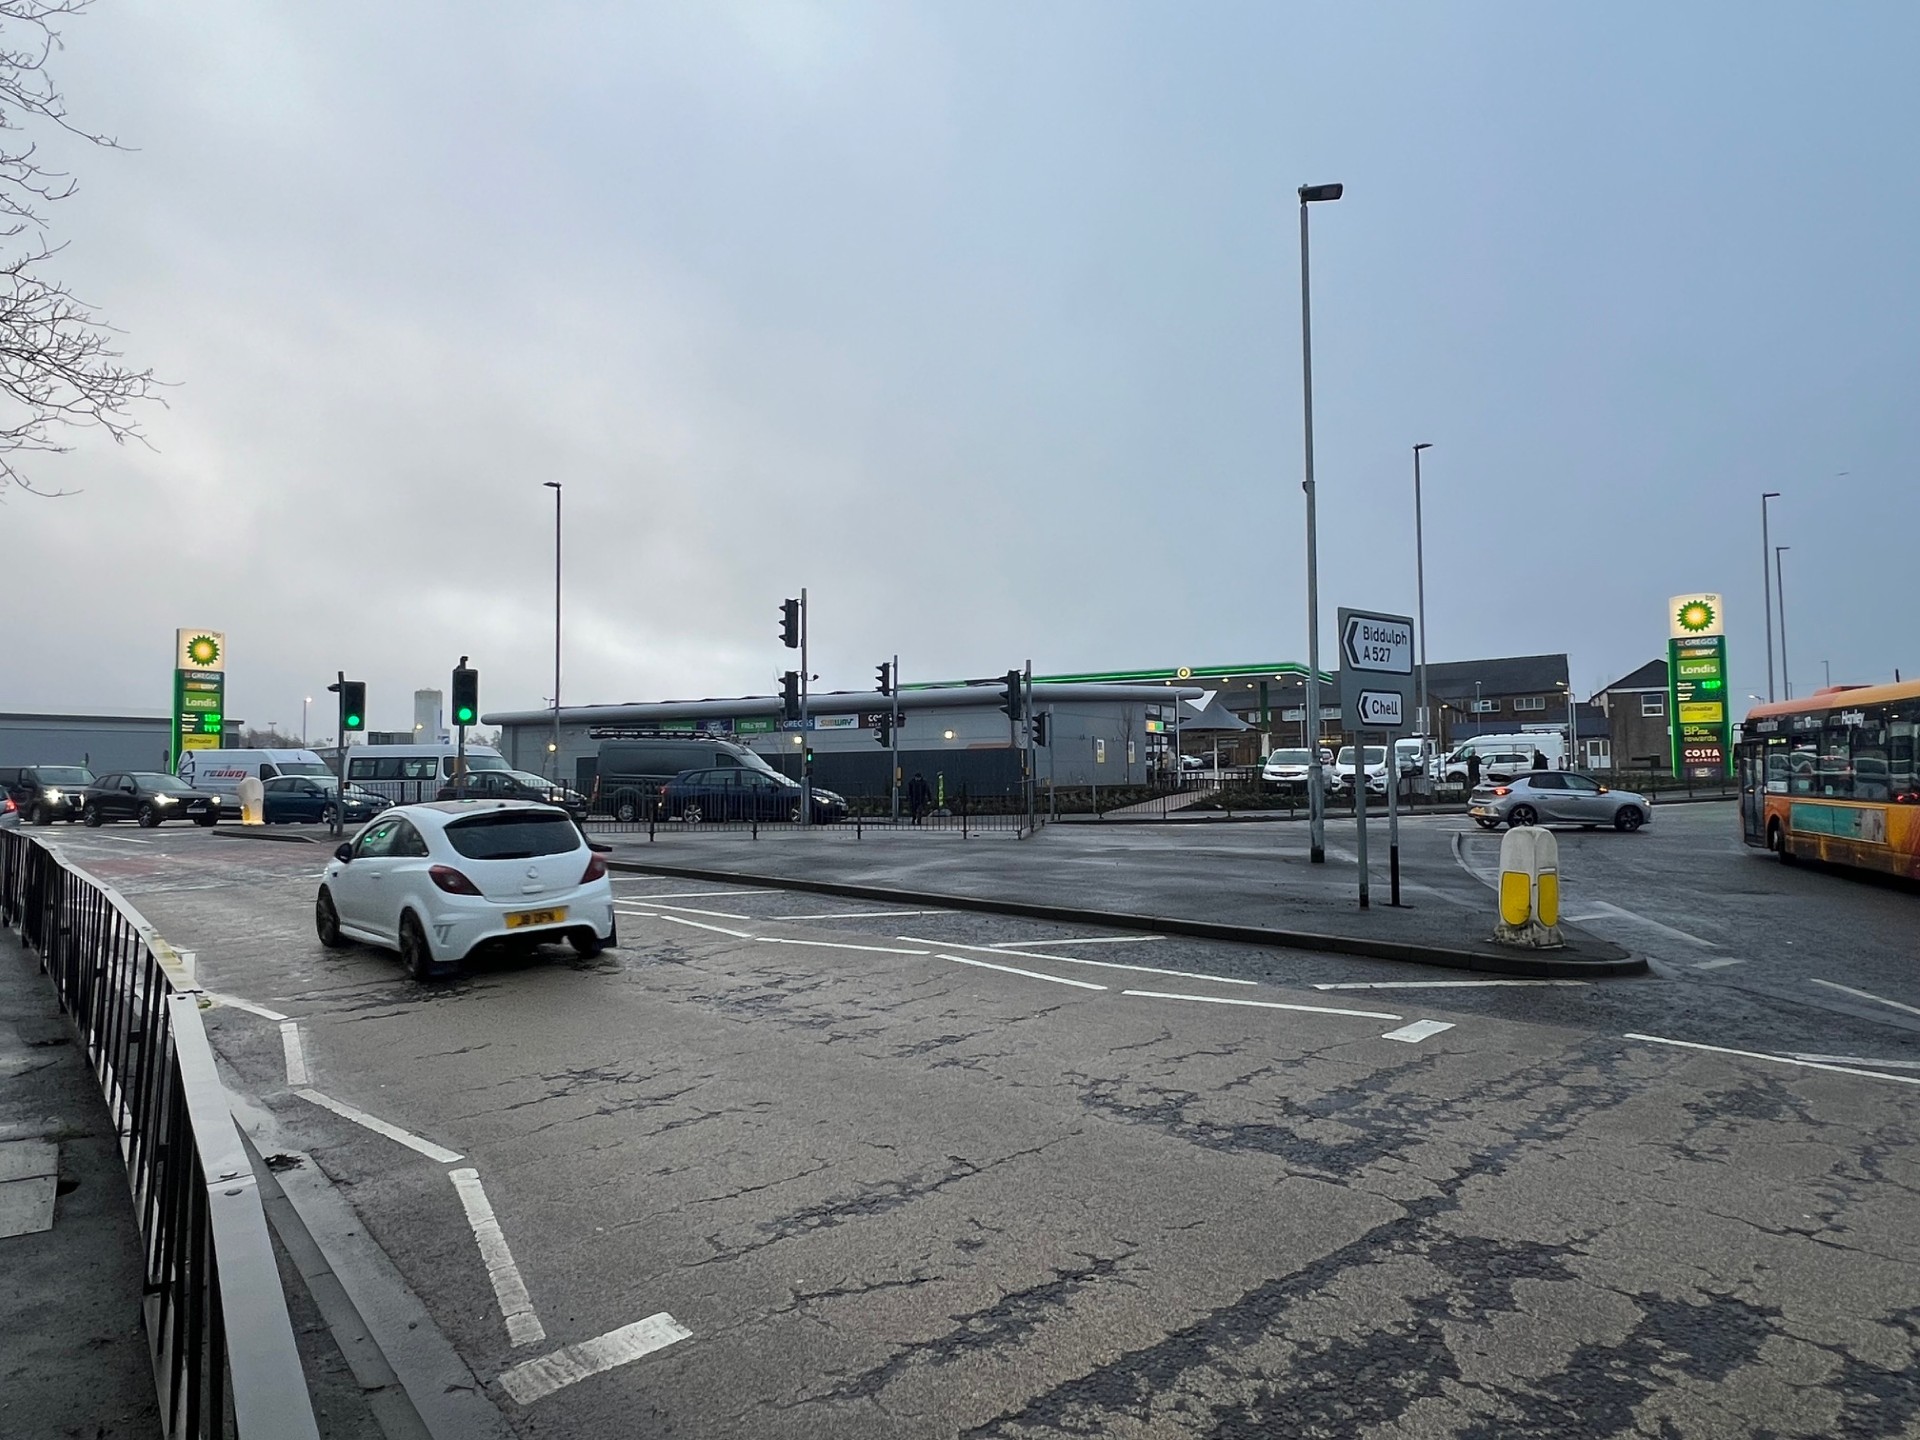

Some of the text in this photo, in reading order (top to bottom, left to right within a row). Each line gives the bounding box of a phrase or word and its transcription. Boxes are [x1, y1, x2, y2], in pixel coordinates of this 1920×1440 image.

[1363, 626, 1407, 646] Biddulph
[1685, 638, 1718, 646] GREGGS
[1363, 646, 1391, 662] A 527
[1680, 664, 1717, 674] Londis
[191, 672, 221, 681] GREGGS
[185, 697, 217, 707] Londis
[1372, 700, 1398, 715] Chell
[819, 718, 854, 727] SUBWAY
[1684, 749, 1720, 757] COSTA
